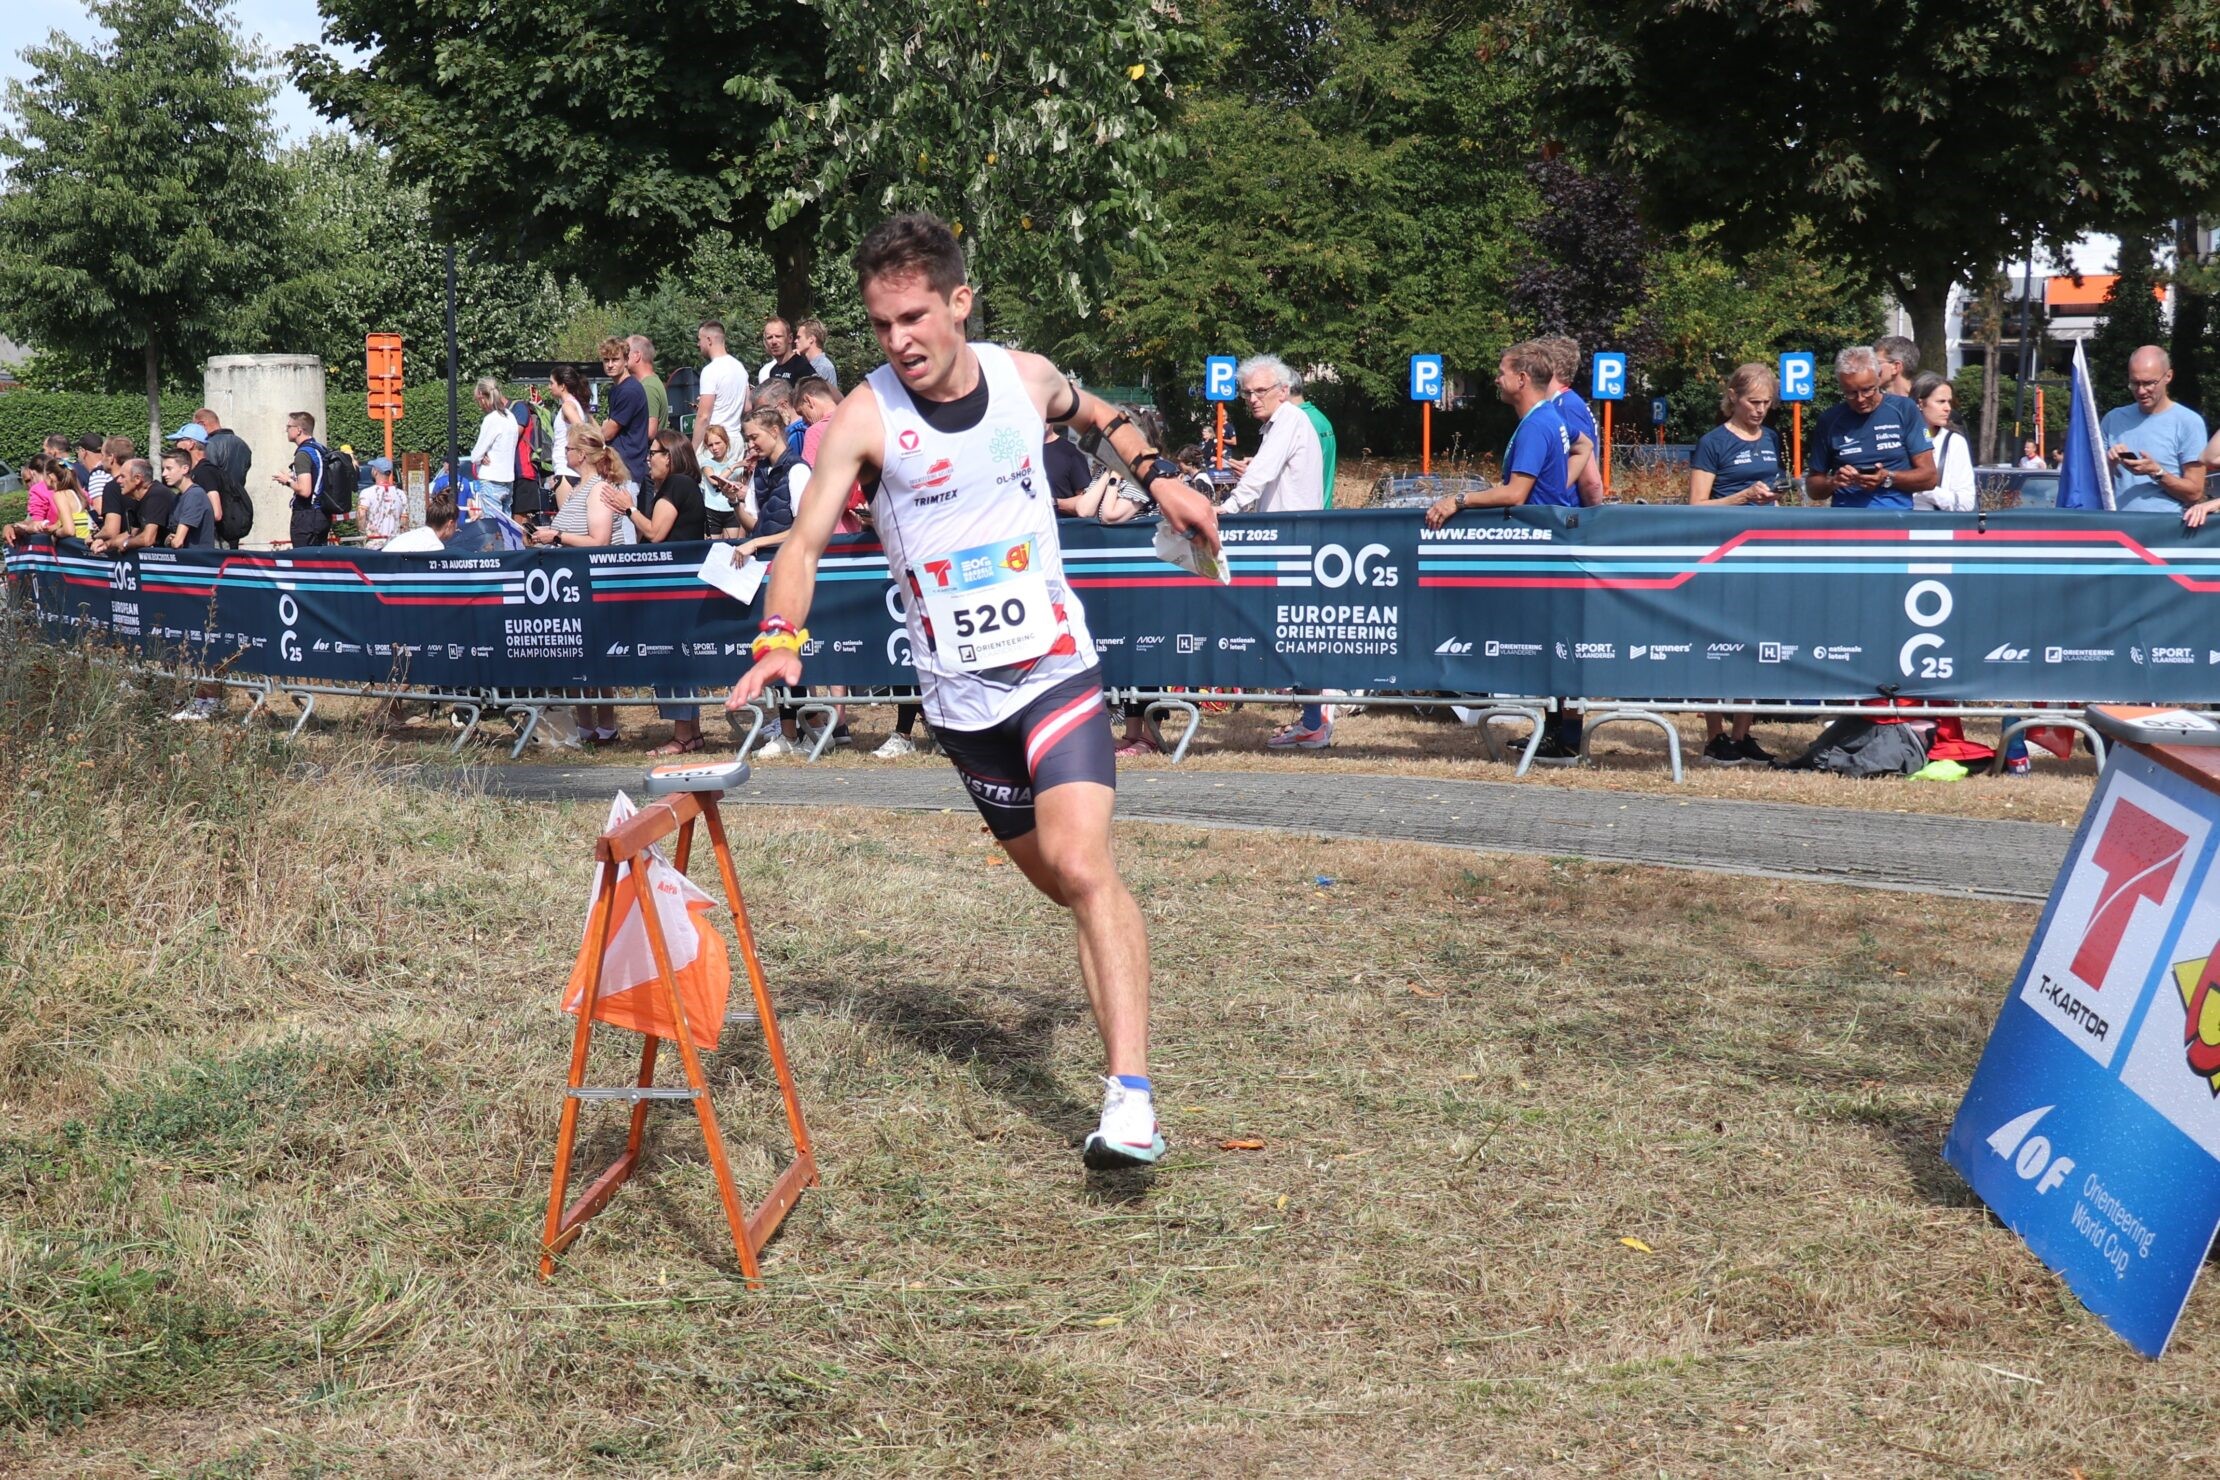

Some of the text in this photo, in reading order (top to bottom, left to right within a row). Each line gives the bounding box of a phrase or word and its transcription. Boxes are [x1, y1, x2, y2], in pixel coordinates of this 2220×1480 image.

[1211, 363, 1233, 393] P
[1416, 361, 1438, 393] P
[1598, 359, 1622, 392] P
[1786, 360, 1810, 393] P
[914, 489, 958, 507] TRIMTEX
[1217, 529, 1278, 541] UST 2025
[1420, 528, 1552, 541] WWW.EOC2025.BE
[450, 559, 478, 569] AUGUST
[479, 559, 500, 568] 2025
[589, 551, 673, 564] WWW.EOC2025.BE
[953, 598, 1025, 637] 520
[1277, 605, 1398, 624] EUROPEAN
[505, 618, 582, 634] EUROPEAN
[1275, 625, 1398, 640] ORIENTEERING
[506, 635, 583, 646] ORIENTEERING
[507, 647, 584, 658] CHAMPIONSHIPS
[1096, 644, 1108, 652] lab
[1230, 644, 1246, 652] loterij
[1275, 641, 1398, 655] CHAMPIONSHIPS
[1575, 643, 1615, 653] SPORT.
[2062, 649, 2115, 657] ORIENTEERING
[2152, 647, 2195, 658] SPORT.
[1650, 651, 1666, 660] lab
[1828, 652, 1850, 661] loterij
[2040, 974, 2109, 1042] T-KARTOR
[2083, 1173, 2156, 1258] Orienteering
[2071, 1200, 2129, 1277] World Cup
